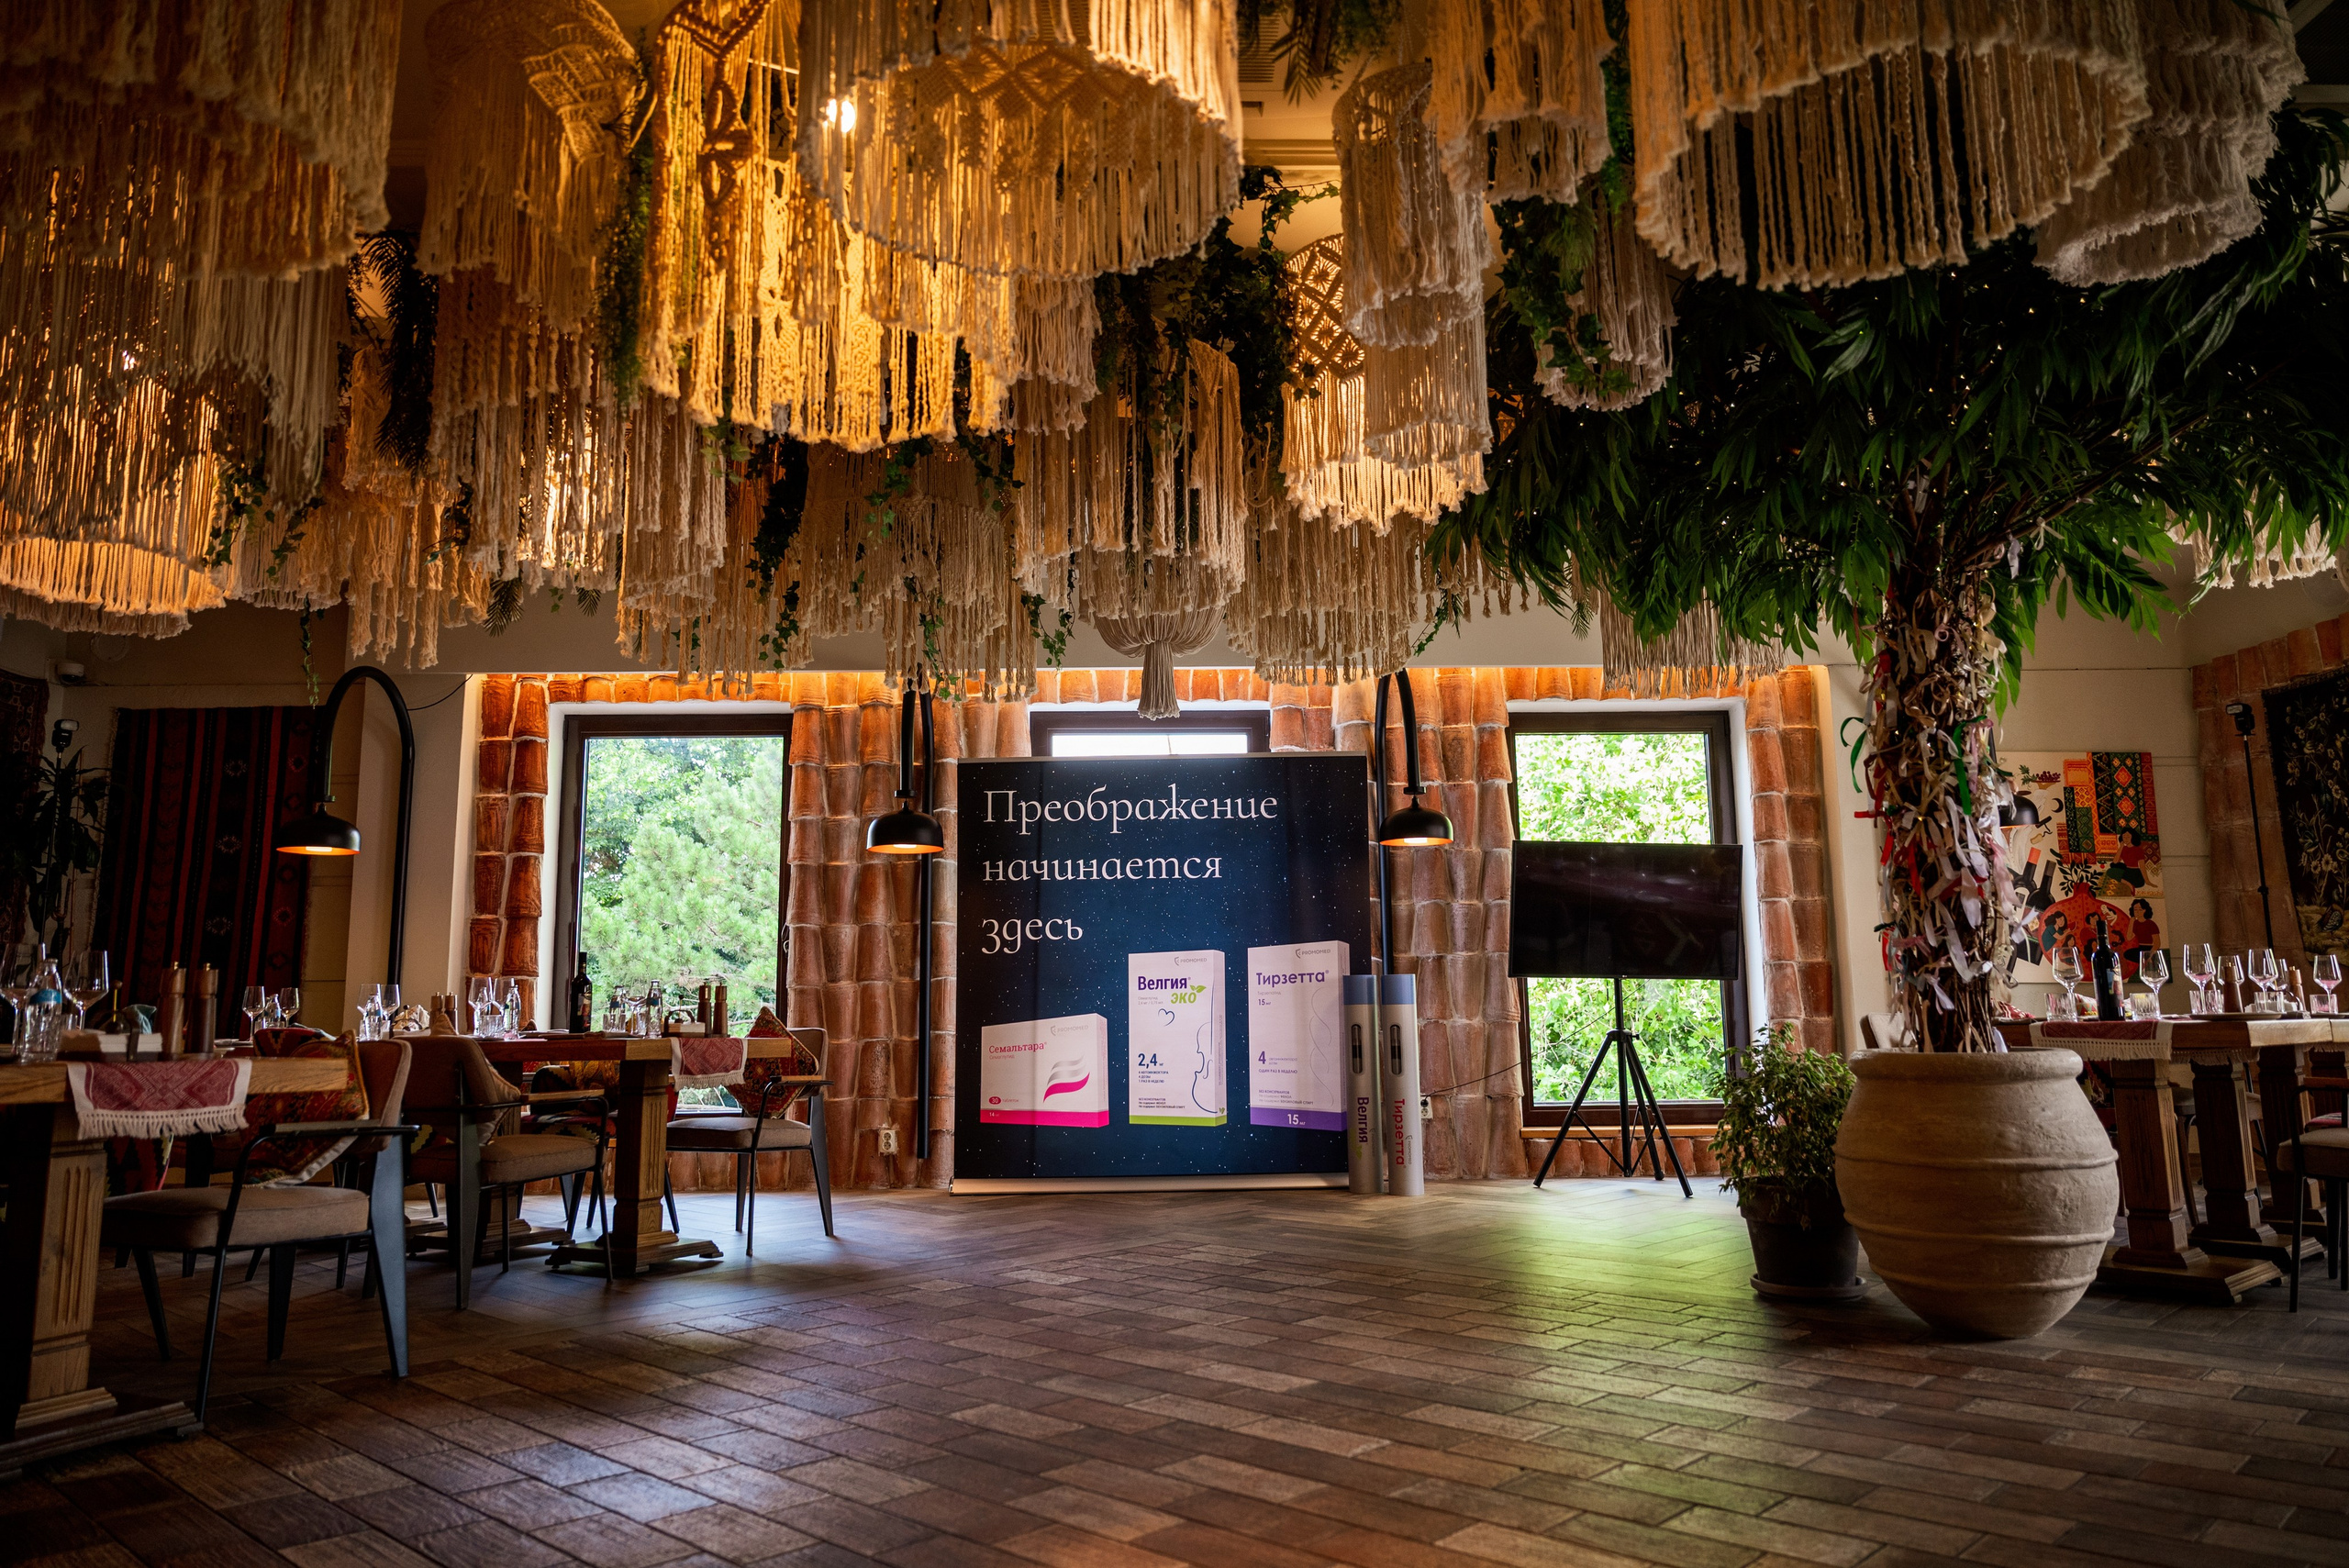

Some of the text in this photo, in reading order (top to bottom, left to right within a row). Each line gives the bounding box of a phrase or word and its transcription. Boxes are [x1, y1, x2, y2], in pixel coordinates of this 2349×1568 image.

[983, 784, 1278, 835] Преображение
[982, 856, 1222, 882] начинается
[981, 917, 1083, 954] здесь
[1138, 976, 1187, 990] Велгия
[1256, 972, 1325, 987] Тирзетта
[1057, 1025, 1089, 1033] PROMOMED
[989, 1042, 1044, 1054] Семальтара
[1138, 1053, 1158, 1069] 2,4
[1258, 1051, 1266, 1064] 4
[1287, 1114, 1299, 1125] 15
[1357, 1097, 1369, 1143] Велгия
[1392, 1099, 1405, 1165] Тирзетта
